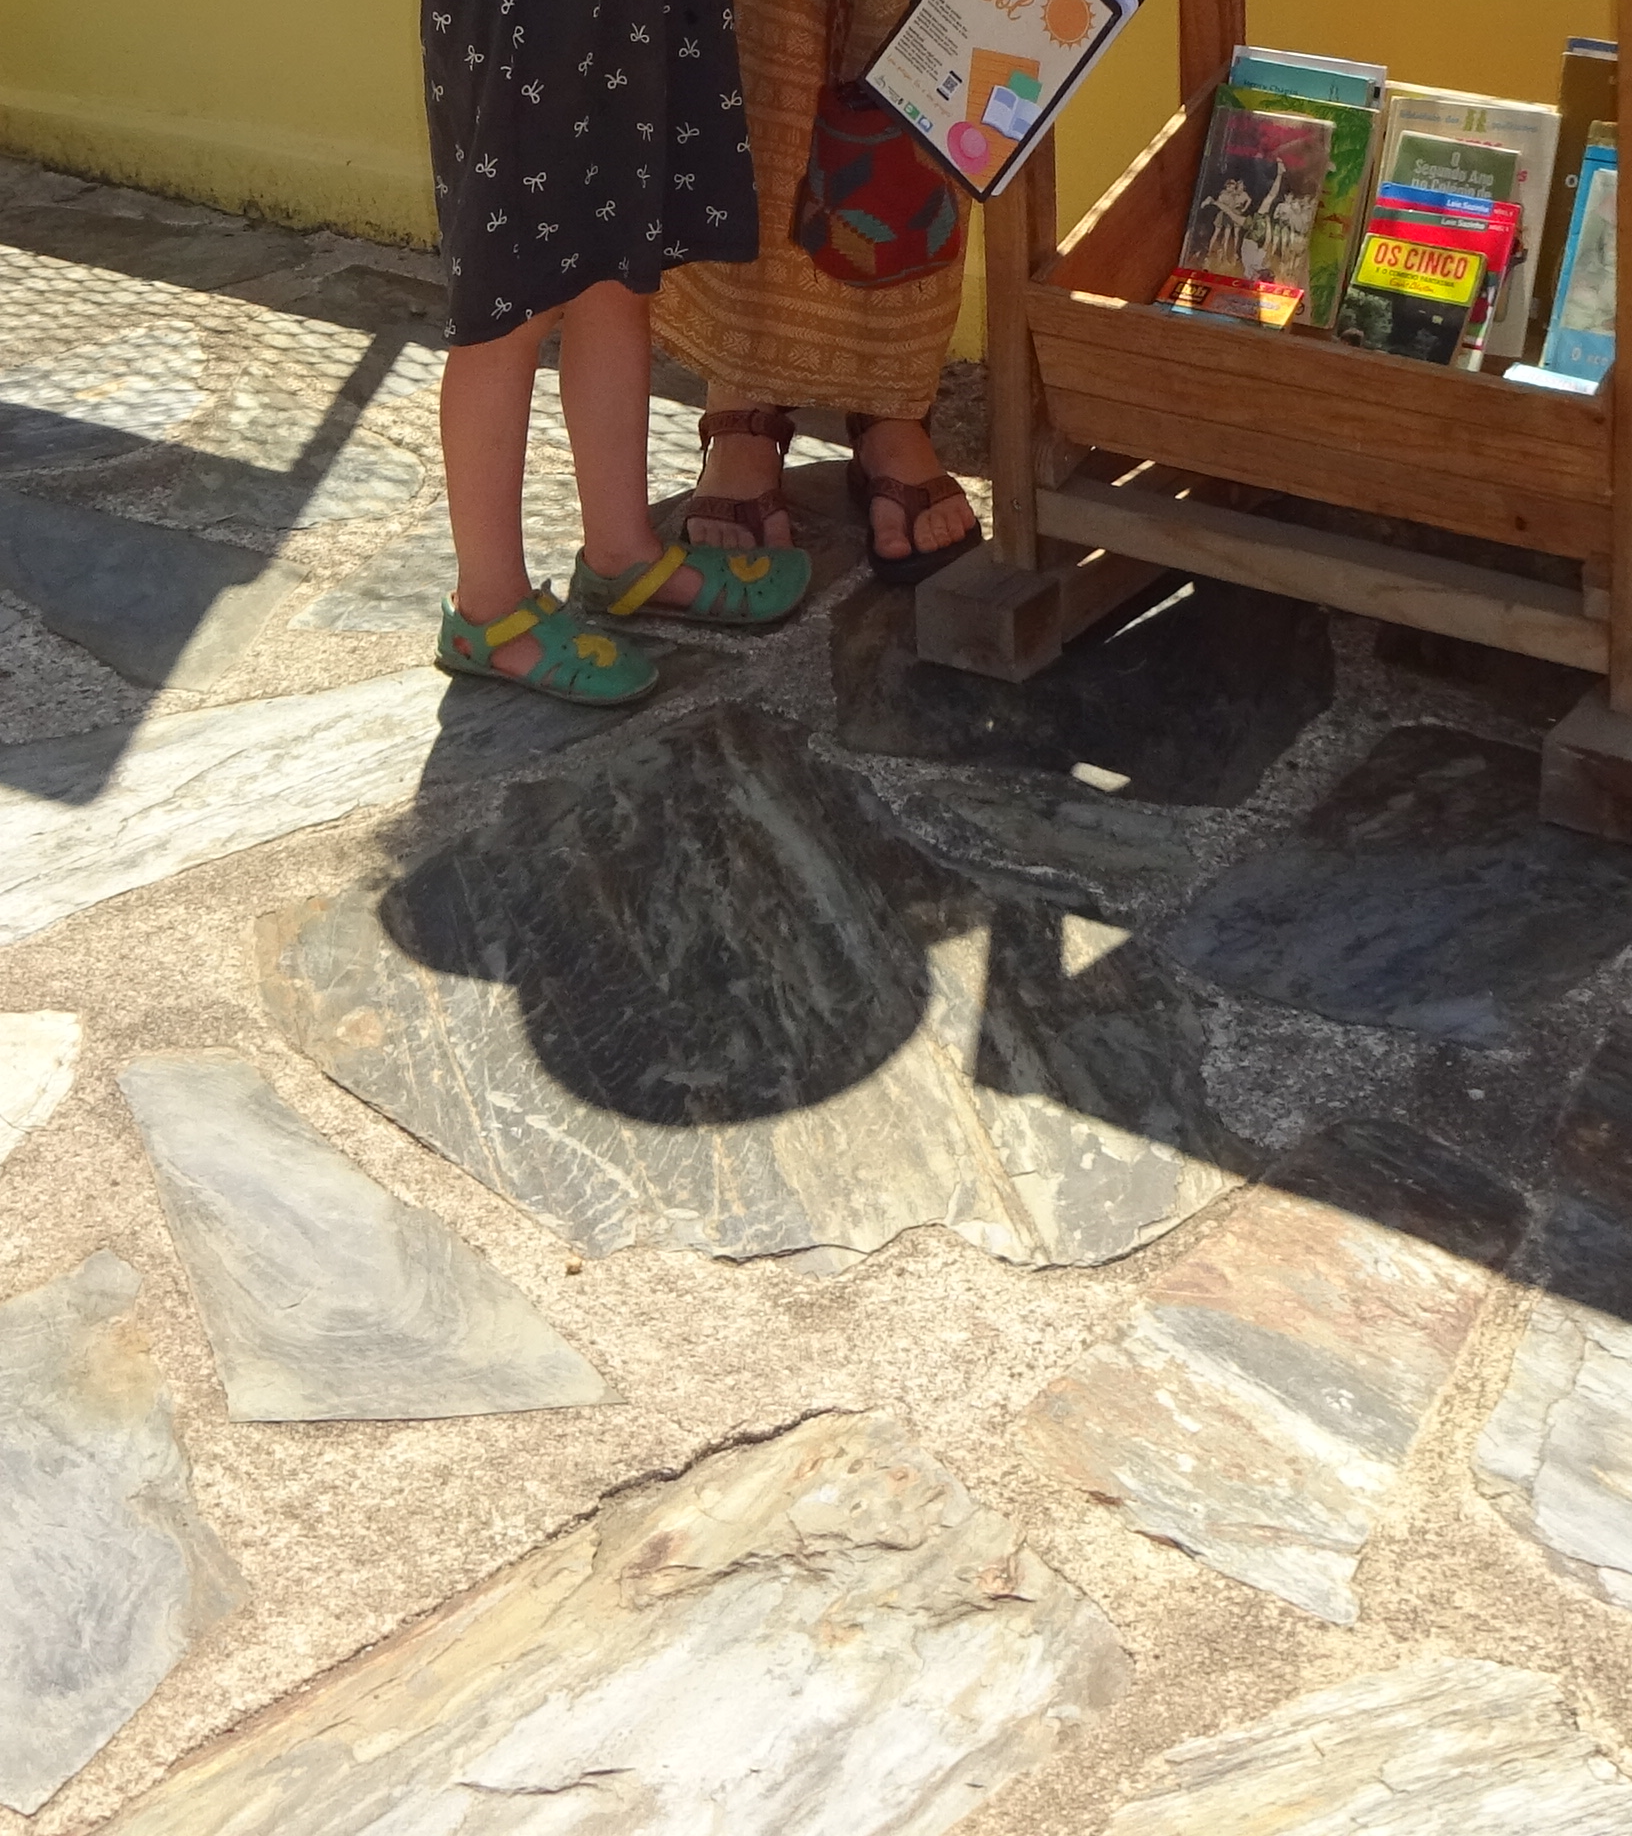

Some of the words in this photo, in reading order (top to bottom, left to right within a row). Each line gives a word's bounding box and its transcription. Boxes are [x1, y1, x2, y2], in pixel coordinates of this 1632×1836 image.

[1415, 158, 1467, 182] Segundo
[1469, 169, 1494, 187] Ano
[1374, 242, 1402, 267] OS
[1404, 247, 1468, 280] CINCO
